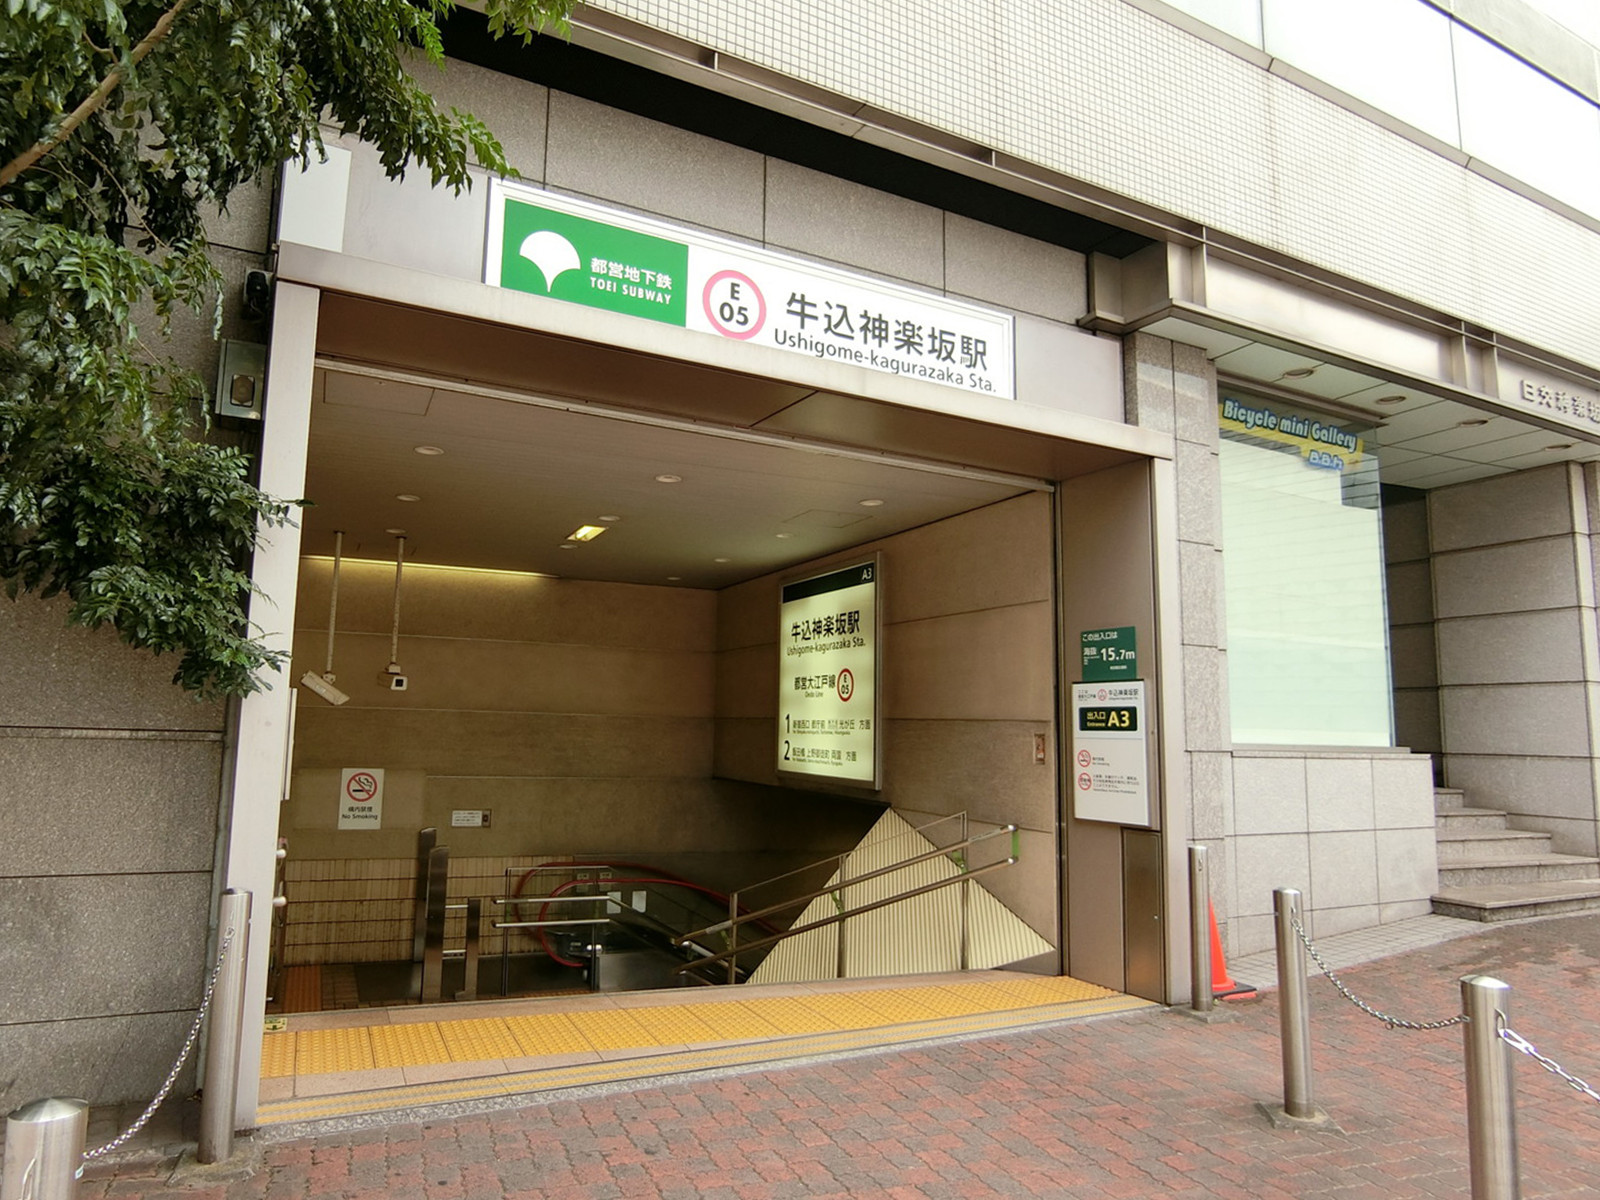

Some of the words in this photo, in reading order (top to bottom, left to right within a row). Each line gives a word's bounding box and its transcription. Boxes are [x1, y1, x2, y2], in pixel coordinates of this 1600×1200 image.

[591, 257, 672, 290] 都営地下鉄
[590, 276, 617, 293] TOEI
[622, 284, 671, 305] SUBWAY
[730, 282, 741, 301] E
[719, 301, 749, 326] 05
[786, 292, 988, 371] 牛込神楽坂駅
[774, 328, 964, 385] Ushigome-kagurazaka
[969, 372, 997, 393] Sta.
[1223, 399, 1277, 429] Bicycle
[1279, 416, 1309, 438] mini
[1311, 421, 1357, 452] Gallery
[862, 567, 872, 581] A3
[791, 610, 860, 643] 牛込神楽坂駅
[787, 638, 851, 657] Ushigome-kagurazaka
[853, 636, 866, 648] Sta.
[1100, 647, 1135, 661] 15.7m
[794, 674, 836, 691] 都営大江戸線
[841, 684, 849, 695] 05
[785, 713, 790, 734] 1
[1086, 711, 1106, 720] 出入口
[1107, 710, 1130, 727] A3
[784, 740, 790, 760] 2
